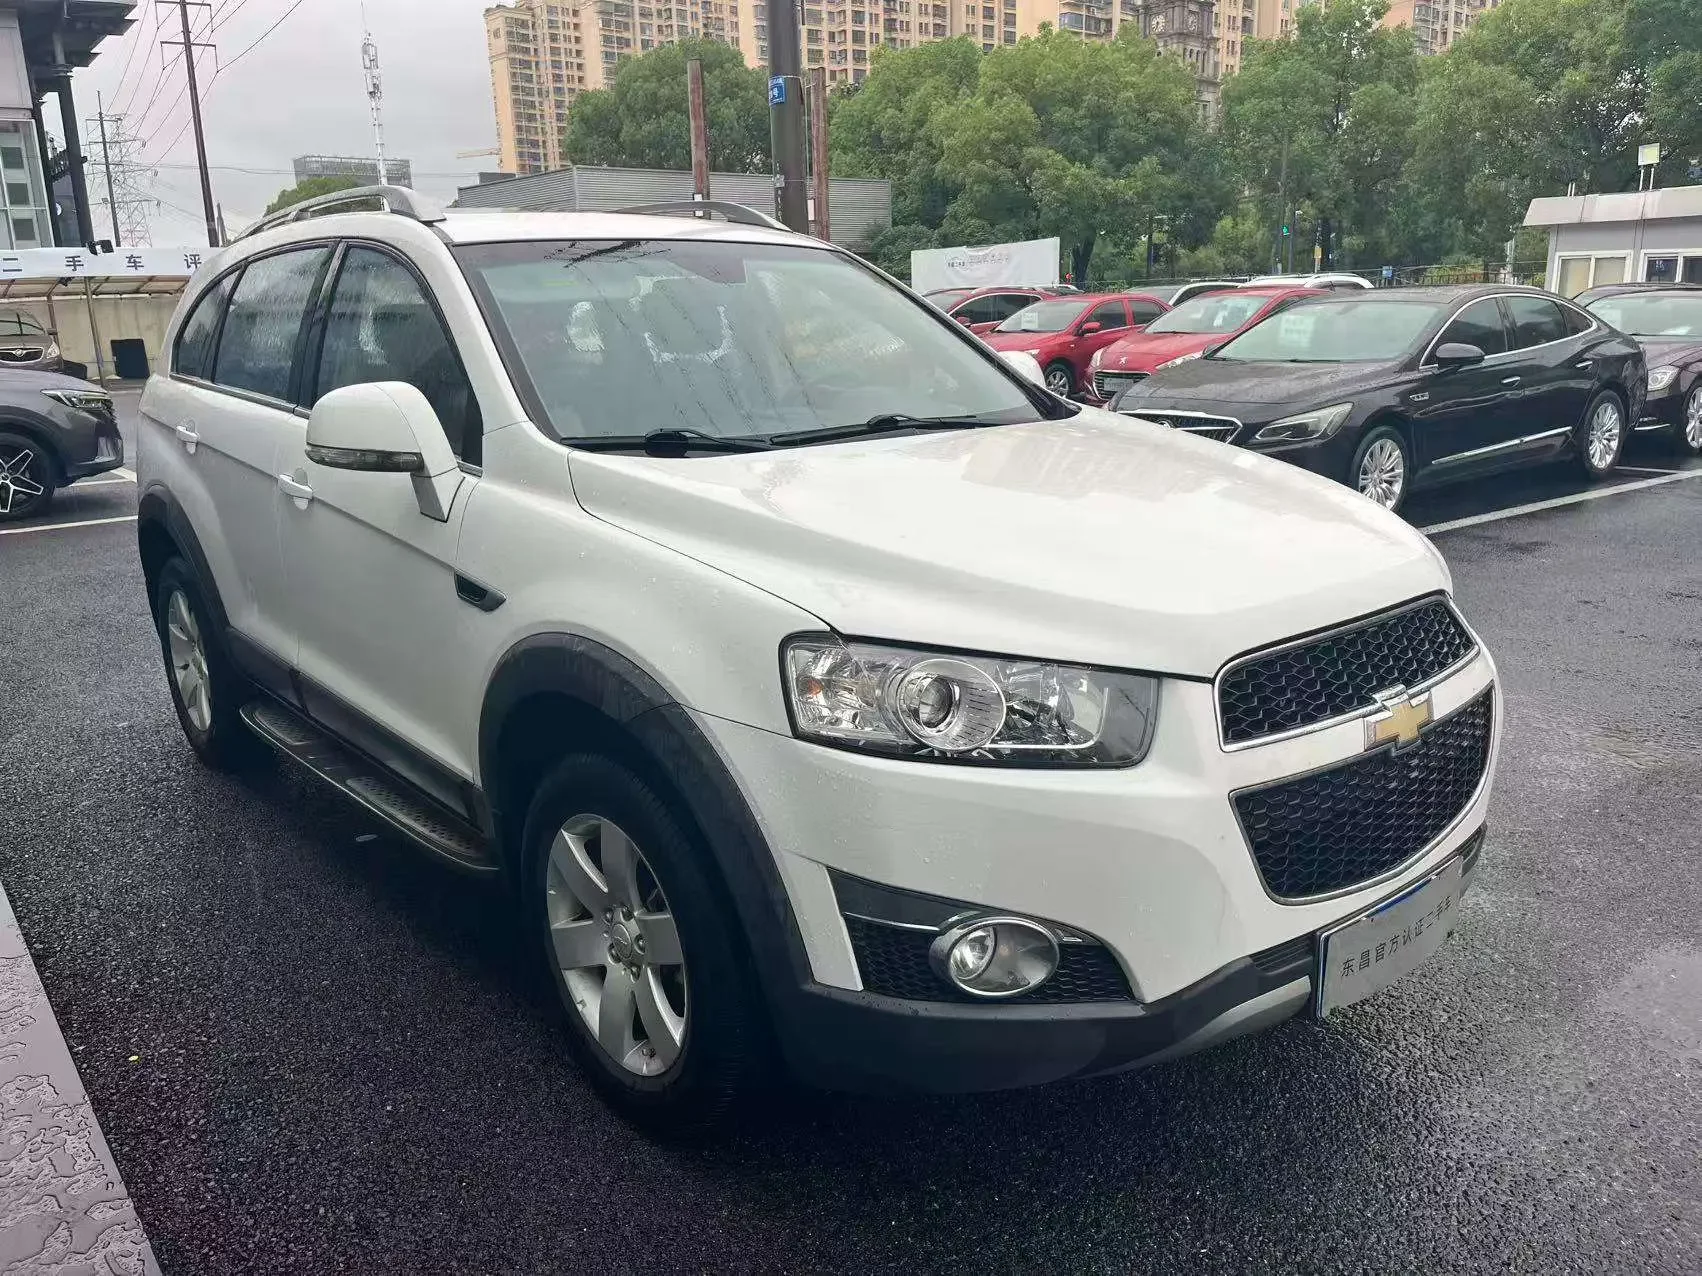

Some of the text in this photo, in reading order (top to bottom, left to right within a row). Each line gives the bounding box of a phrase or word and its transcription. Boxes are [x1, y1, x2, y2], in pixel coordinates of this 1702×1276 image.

[2, 253, 202, 273] 二手车评
[1340, 895, 1453, 978] 东昌官方认证二手车
